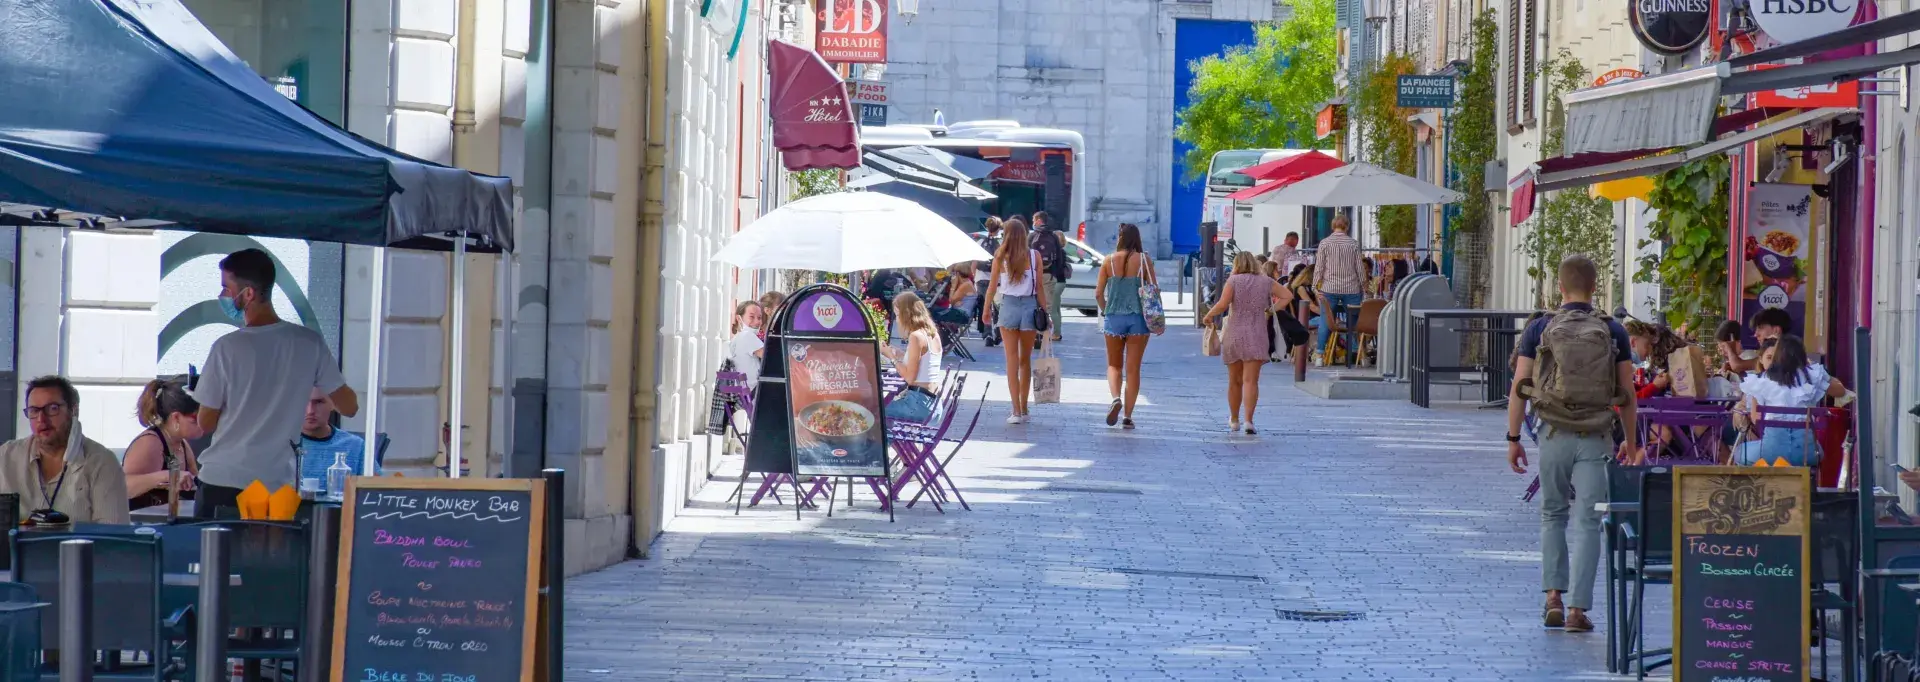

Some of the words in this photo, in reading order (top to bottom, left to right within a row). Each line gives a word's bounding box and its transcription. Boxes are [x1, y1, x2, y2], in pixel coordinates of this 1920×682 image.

[1640, 0, 1708, 13] GUINNESS
[1761, 0, 1850, 14] HSBC
[821, 0, 882, 34] LD
[822, 37, 881, 48] DABADIE
[823, 50, 879, 58] IMMOBILIER
[860, 84, 886, 92] FAST
[1400, 78, 1412, 86] LA
[1413, 77, 1451, 87] FIANCÉE
[1416, 87, 1451, 95] PIRATE
[857, 93, 887, 102] FOOD
[804, 108, 842, 122] Hôtel
[863, 106, 884, 117] FIKA
[425, 497, 479, 511] MONKEY
[434, 536, 474, 548] BOWL
[1686, 536, 1760, 558] FROZEN
[1700, 563, 1752, 577] BOISSON
[1754, 562, 1795, 577] GLACÉE
[1704, 596, 1755, 610] CERISE
[1702, 618, 1752, 631] PASSION
[461, 640, 488, 651] OREO
[1706, 640, 1754, 649] MANGUE
[1695, 660, 1738, 670] ORANGE
[1747, 660, 1793, 674] SPRITZ
[416, 672, 435, 682] DU
